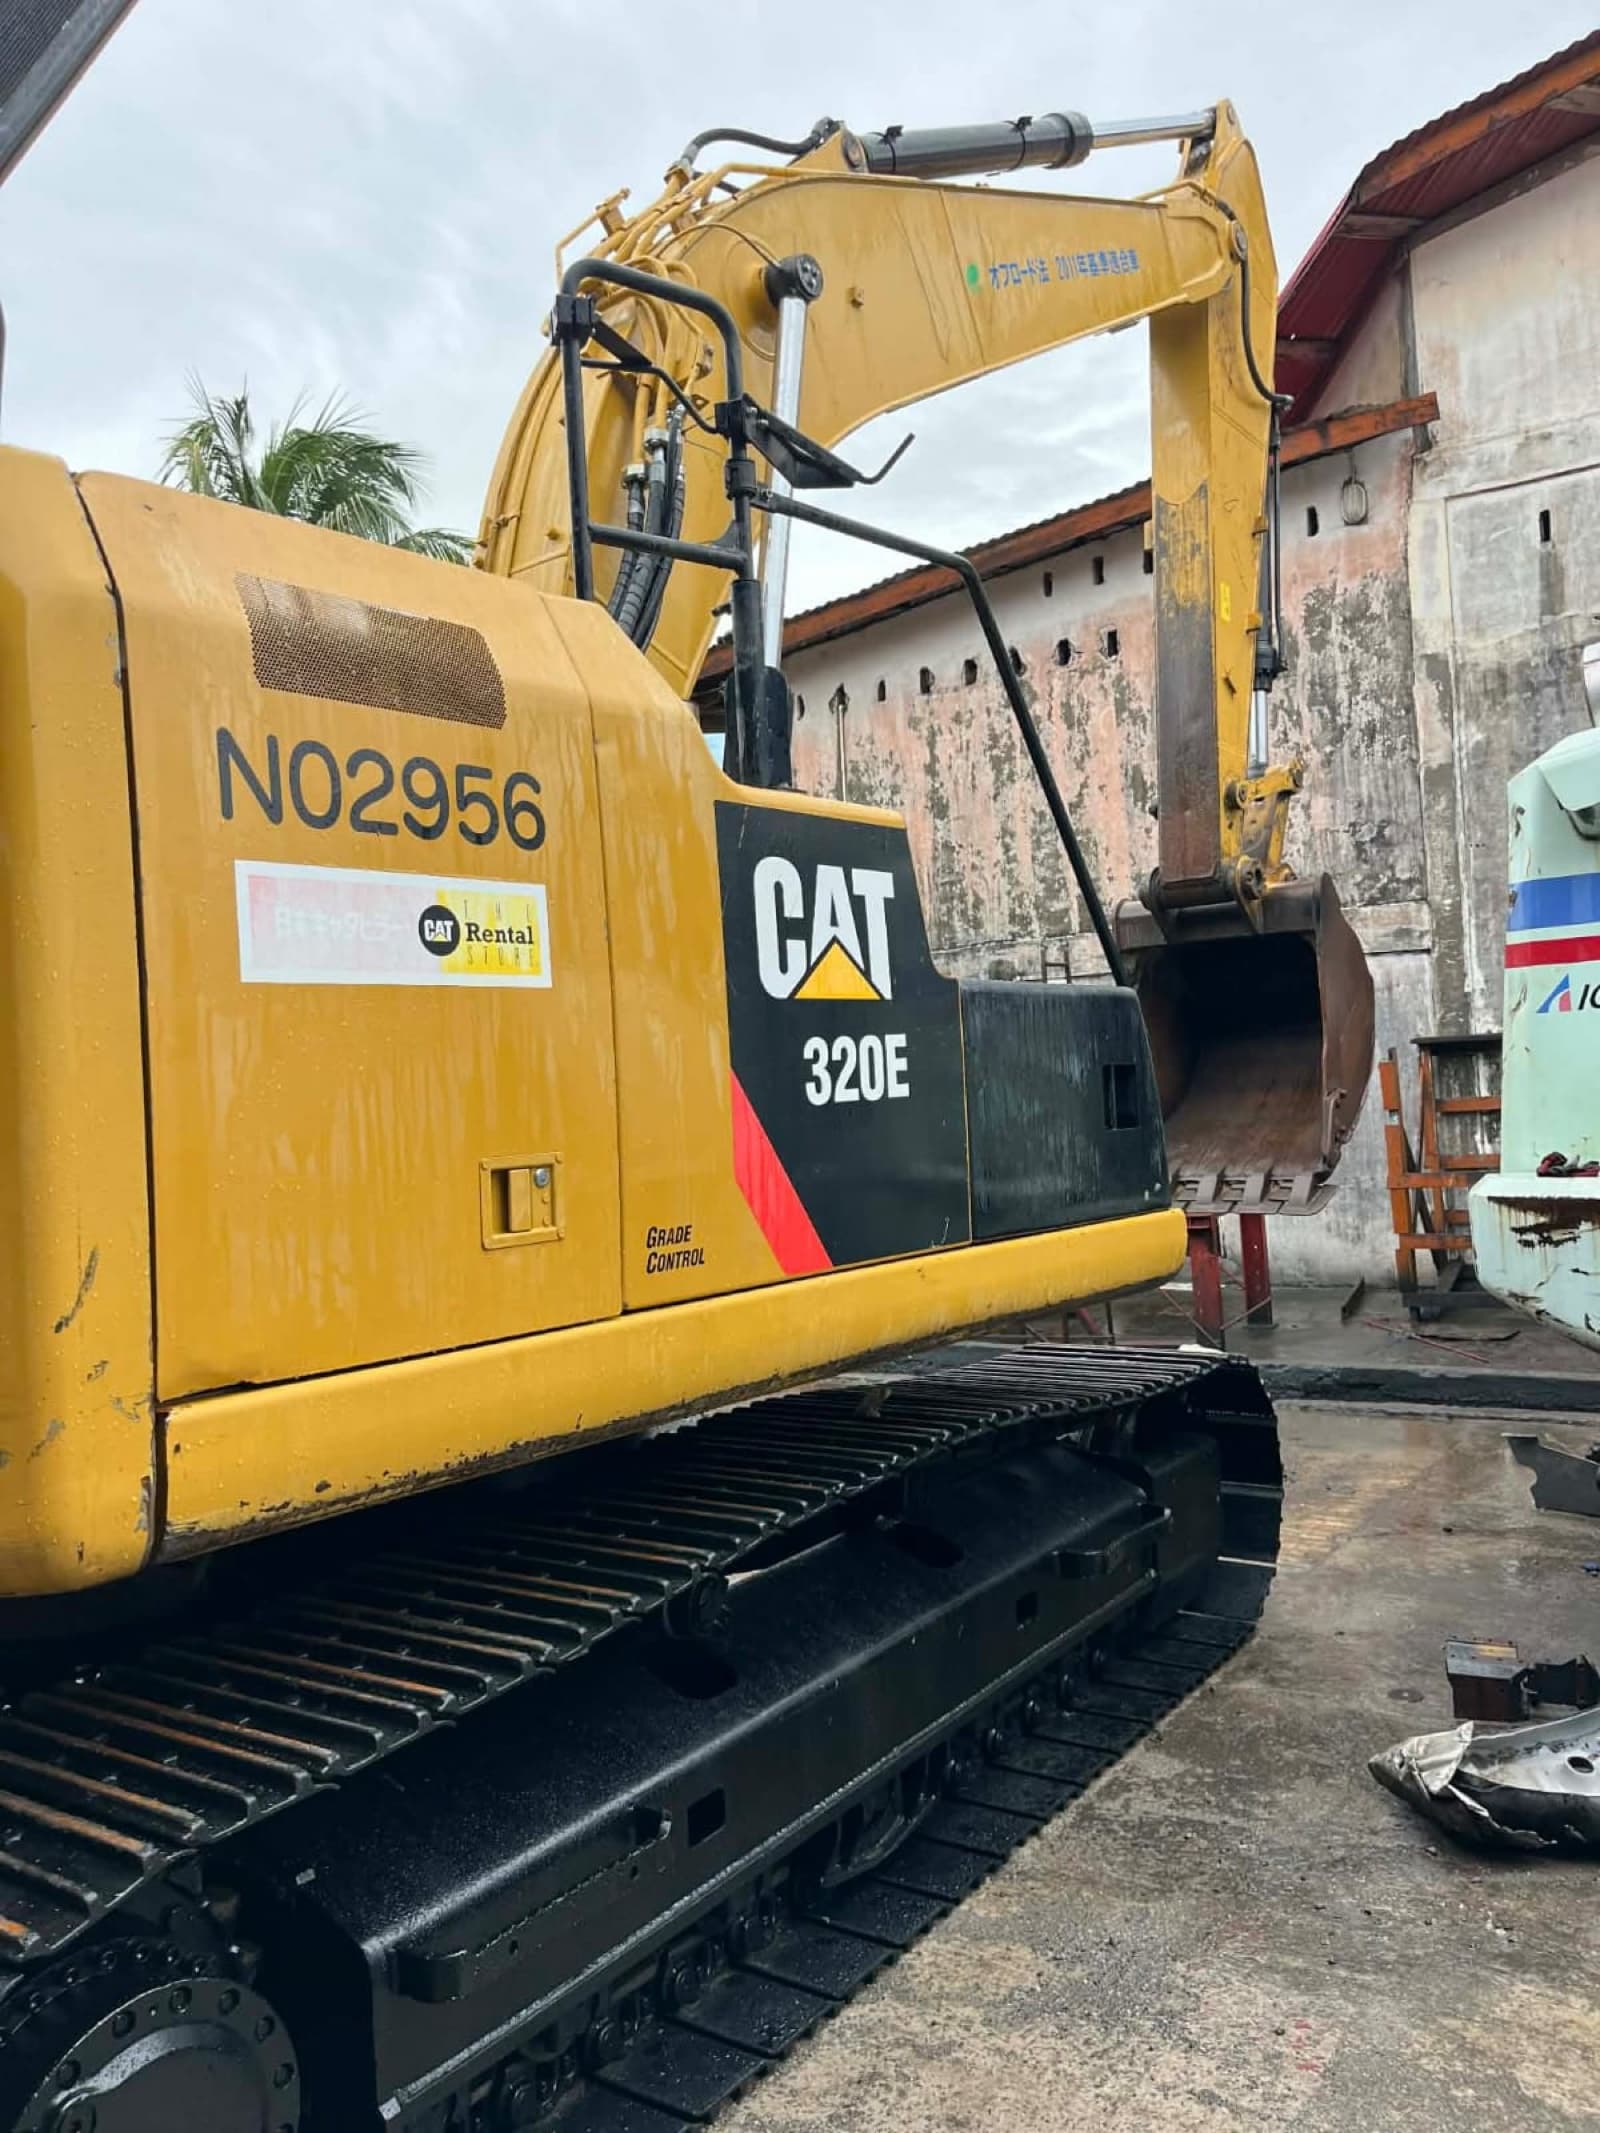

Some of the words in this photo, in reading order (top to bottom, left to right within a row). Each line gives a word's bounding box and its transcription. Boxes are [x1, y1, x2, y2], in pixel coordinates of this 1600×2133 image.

[424, 919, 454, 942] CAT
[465, 922, 534, 945] Rental
[753, 856, 895, 1000] CAT
[803, 1034, 911, 1106] 320E
[646, 1225, 692, 1249] GRADE
[646, 1248, 705, 1274] CONTROL
